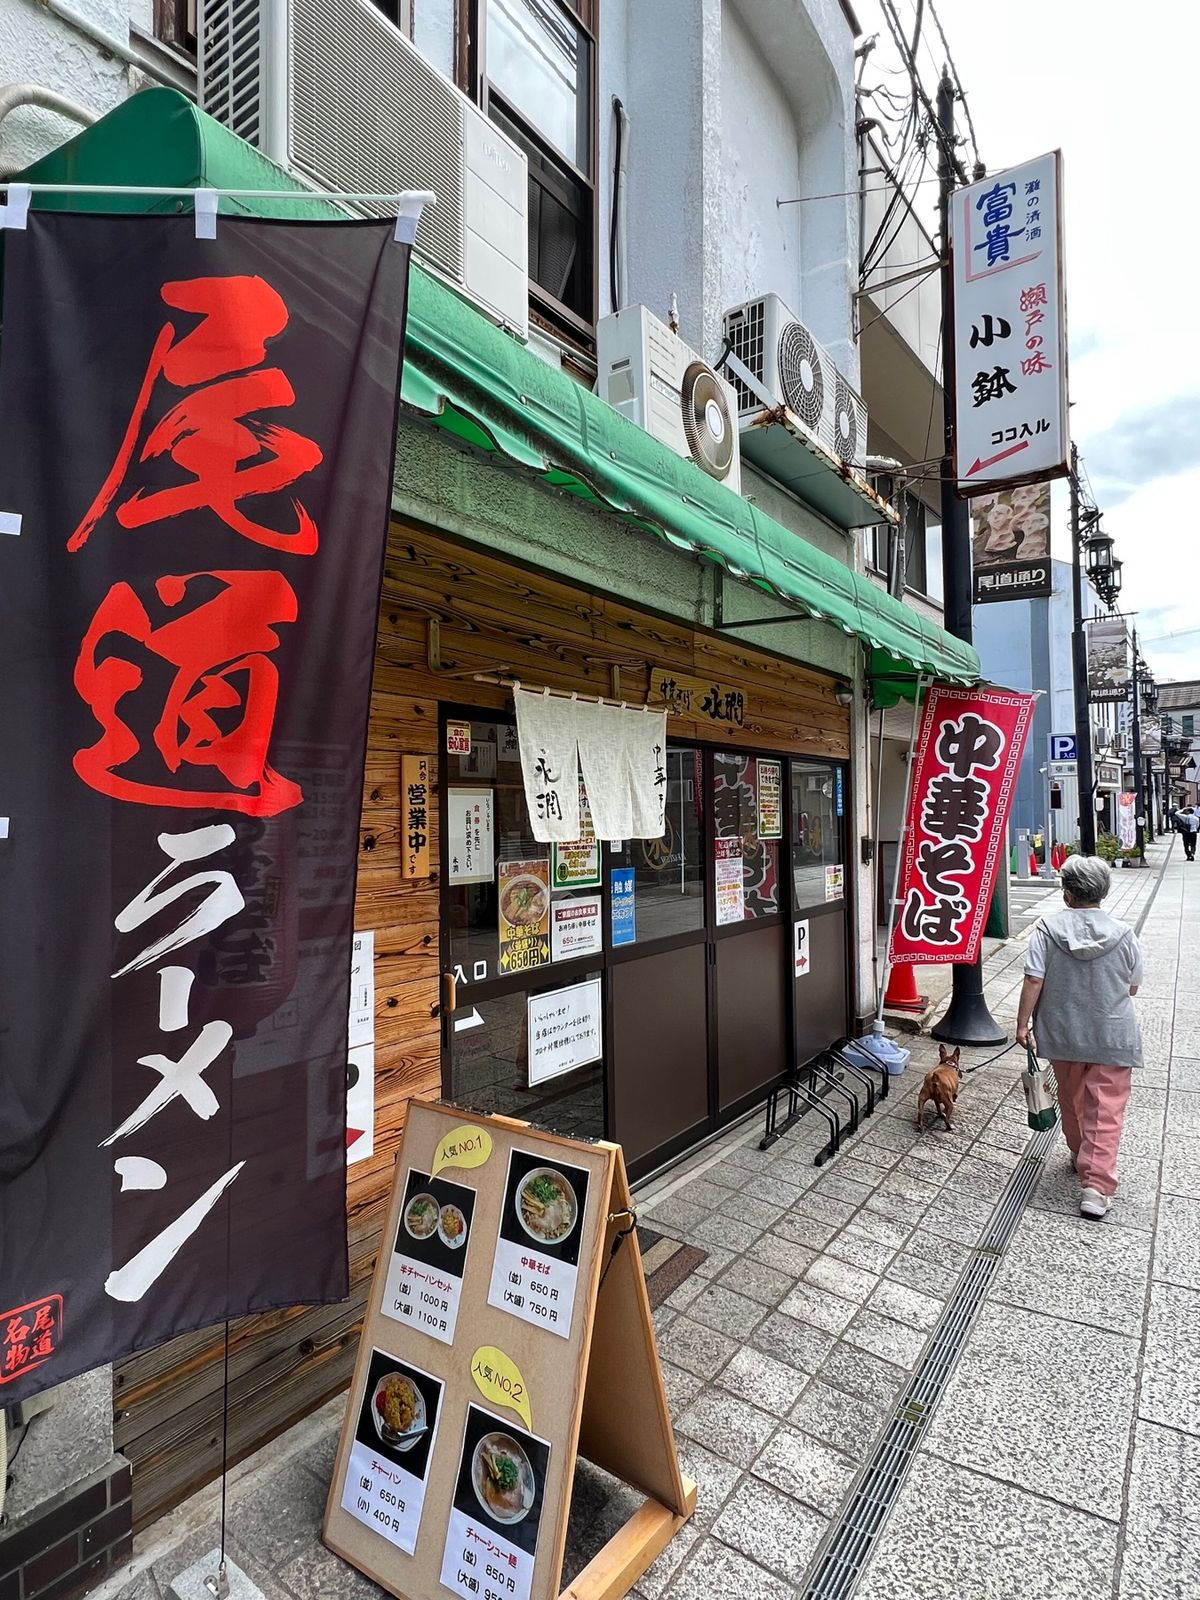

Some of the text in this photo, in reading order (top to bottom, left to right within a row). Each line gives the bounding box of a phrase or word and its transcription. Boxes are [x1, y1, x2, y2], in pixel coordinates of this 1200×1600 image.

[974, 182, 1025, 267] 富貴
[1025, 179, 1041, 241] 灘の清酒
[1019, 283, 1052, 376] 瀬戸の味
[969, 314, 1017, 408] 小鉢
[991, 418, 1050, 445] ココ入ル
[1054, 737, 1074, 759] P
[534, 748, 562, 820] 永潤
[903, 714, 1004, 944] 中華そば
[611, 880, 633, 894] 触媒
[797, 926, 806, 950] P
[454, 960, 487, 985] 入口
[510, 947, 540, 971] 650円
[400, 1264, 452, 1293] 半チャーハンセット
[520, 1256, 551, 1275] 中華そば
[3, 1316, 30, 1370] 名物
[371, 1460, 401, 1485] チャーハン
[465, 1527, 518, 1569] チャーシュー麺
